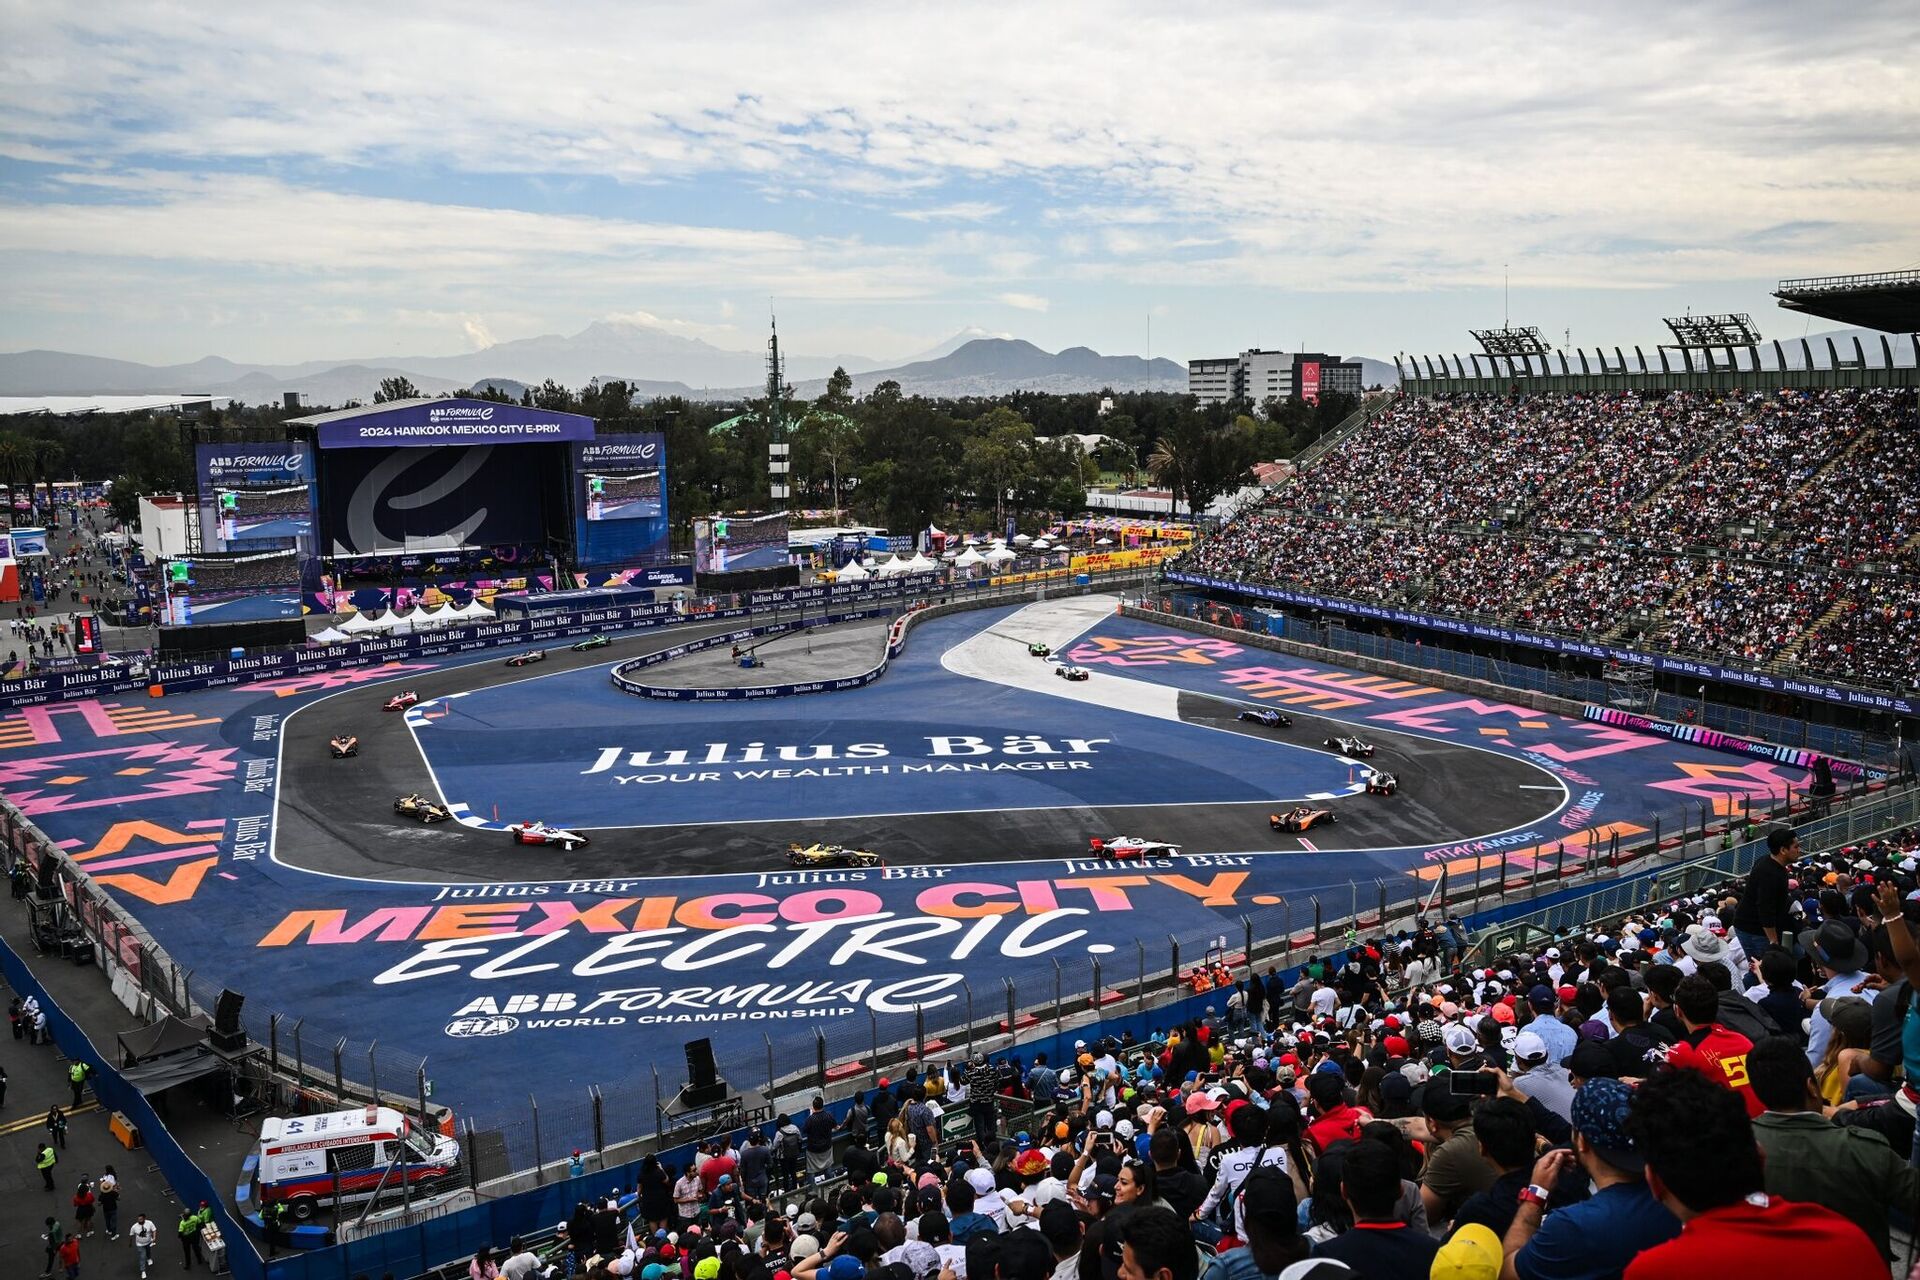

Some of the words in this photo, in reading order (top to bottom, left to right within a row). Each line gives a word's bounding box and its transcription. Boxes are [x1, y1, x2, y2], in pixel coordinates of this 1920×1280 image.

[360, 428, 392, 436] 2024
[394, 426, 450, 436] HANKOOK
[452, 425, 498, 434] MEXICO
[500, 424, 524, 434] CITY
[526, 424, 560, 433] E-PRIX
[601, 445, 641, 455] FORMULA
[210, 458, 232, 466] ABB
[232, 455, 286, 467] FORMULA
[1086, 555, 1110, 564] DHL
[1140, 549, 1162, 558] DHL
[752, 594, 772, 604] Julius
[793, 590, 811, 600] Julius
[582, 612, 605, 623] Julius
[607, 610, 621, 619] Bär
[631, 608, 652, 618] Julius
[654, 606, 668, 614] Bär
[477, 626, 502, 638] Julius
[504, 623, 520, 632] Bär
[531, 618, 554, 630] Julius
[557, 616, 572, 624] Bär
[420, 633, 446, 646] Julius
[448, 630, 466, 640] Bär
[1474, 626, 1489, 635] Julius
[1490, 628, 1500, 637] Bär
[1515, 634, 1532, 642] Julius
[1533, 636, 1542, 644] Bär
[360, 641, 388, 654] Julius
[390, 638, 408, 648] Bär
[1562, 642, 1579, 651] Julius
[1580, 644, 1591, 653] Bär
[296, 650, 326, 662] Julius
[328, 647, 348, 656] Bär
[1629, 653, 1640, 662] Bär
[229, 659, 260, 672] Julius
[263, 655, 282, 666] Bär
[1663, 660, 1682, 670] Julius
[1684, 663, 1697, 672] Bär
[63, 674, 97, 687] Julius
[100, 669, 122, 680] Bär
[158, 668, 190, 682] Julius
[194, 664, 215, 675] Bär
[1721, 670, 1742, 681] Julius
[1744, 673, 1758, 683] Bär
[24, 680, 47, 690] Bär
[1784, 680, 1806, 692] Julius
[1808, 684, 1824, 695] Bär
[1849, 692, 1874, 704] Julius
[1876, 696, 1892, 707] Bär
[251, 714, 279, 730] Julius
[1628, 717, 1672, 734] ATTACKMODE
[253, 730, 278, 740] Bär
[1722, 737, 1774, 756] ATTACKMODE
[580, 742, 890, 774] Julius
[924, 735, 1110, 756] Bär
[243, 758, 275, 778] Julius
[614, 772, 721, 784] YOUR
[733, 765, 890, 780] WEALTH
[903, 761, 1094, 773] MANAGER
[244, 778, 273, 792] Bär
[232, 815, 270, 842] Julius
[233, 842, 266, 860] Bär
[1424, 831, 1544, 861] ATTACKMODE
[1188, 855, 1254, 867] Bär
[756, 870, 867, 888] Julius
[883, 867, 952, 880] Bär
[432, 885, 550, 901] Julius
[564, 880, 638, 894] Bär
[256, 888, 883, 947] MEXICO
[916, 872, 1282, 918] CITY.
[373, 908, 1116, 985] ELECTRIC.
[453, 992, 577, 1017] ABB
[579, 978, 872, 1014] FORMULA
[447, 1017, 514, 1036] FIA
[527, 1016, 626, 1029] WORLD
[638, 1007, 854, 1024] CHAMPIONSHIP
[281, 1144, 312, 1152] AMBULANCIA
[319, 1139, 342, 1147] CUIDADOS
[343, 1136, 370, 1144] INTENSIVOS
[1234, 1157, 1284, 1171] ORCLE
